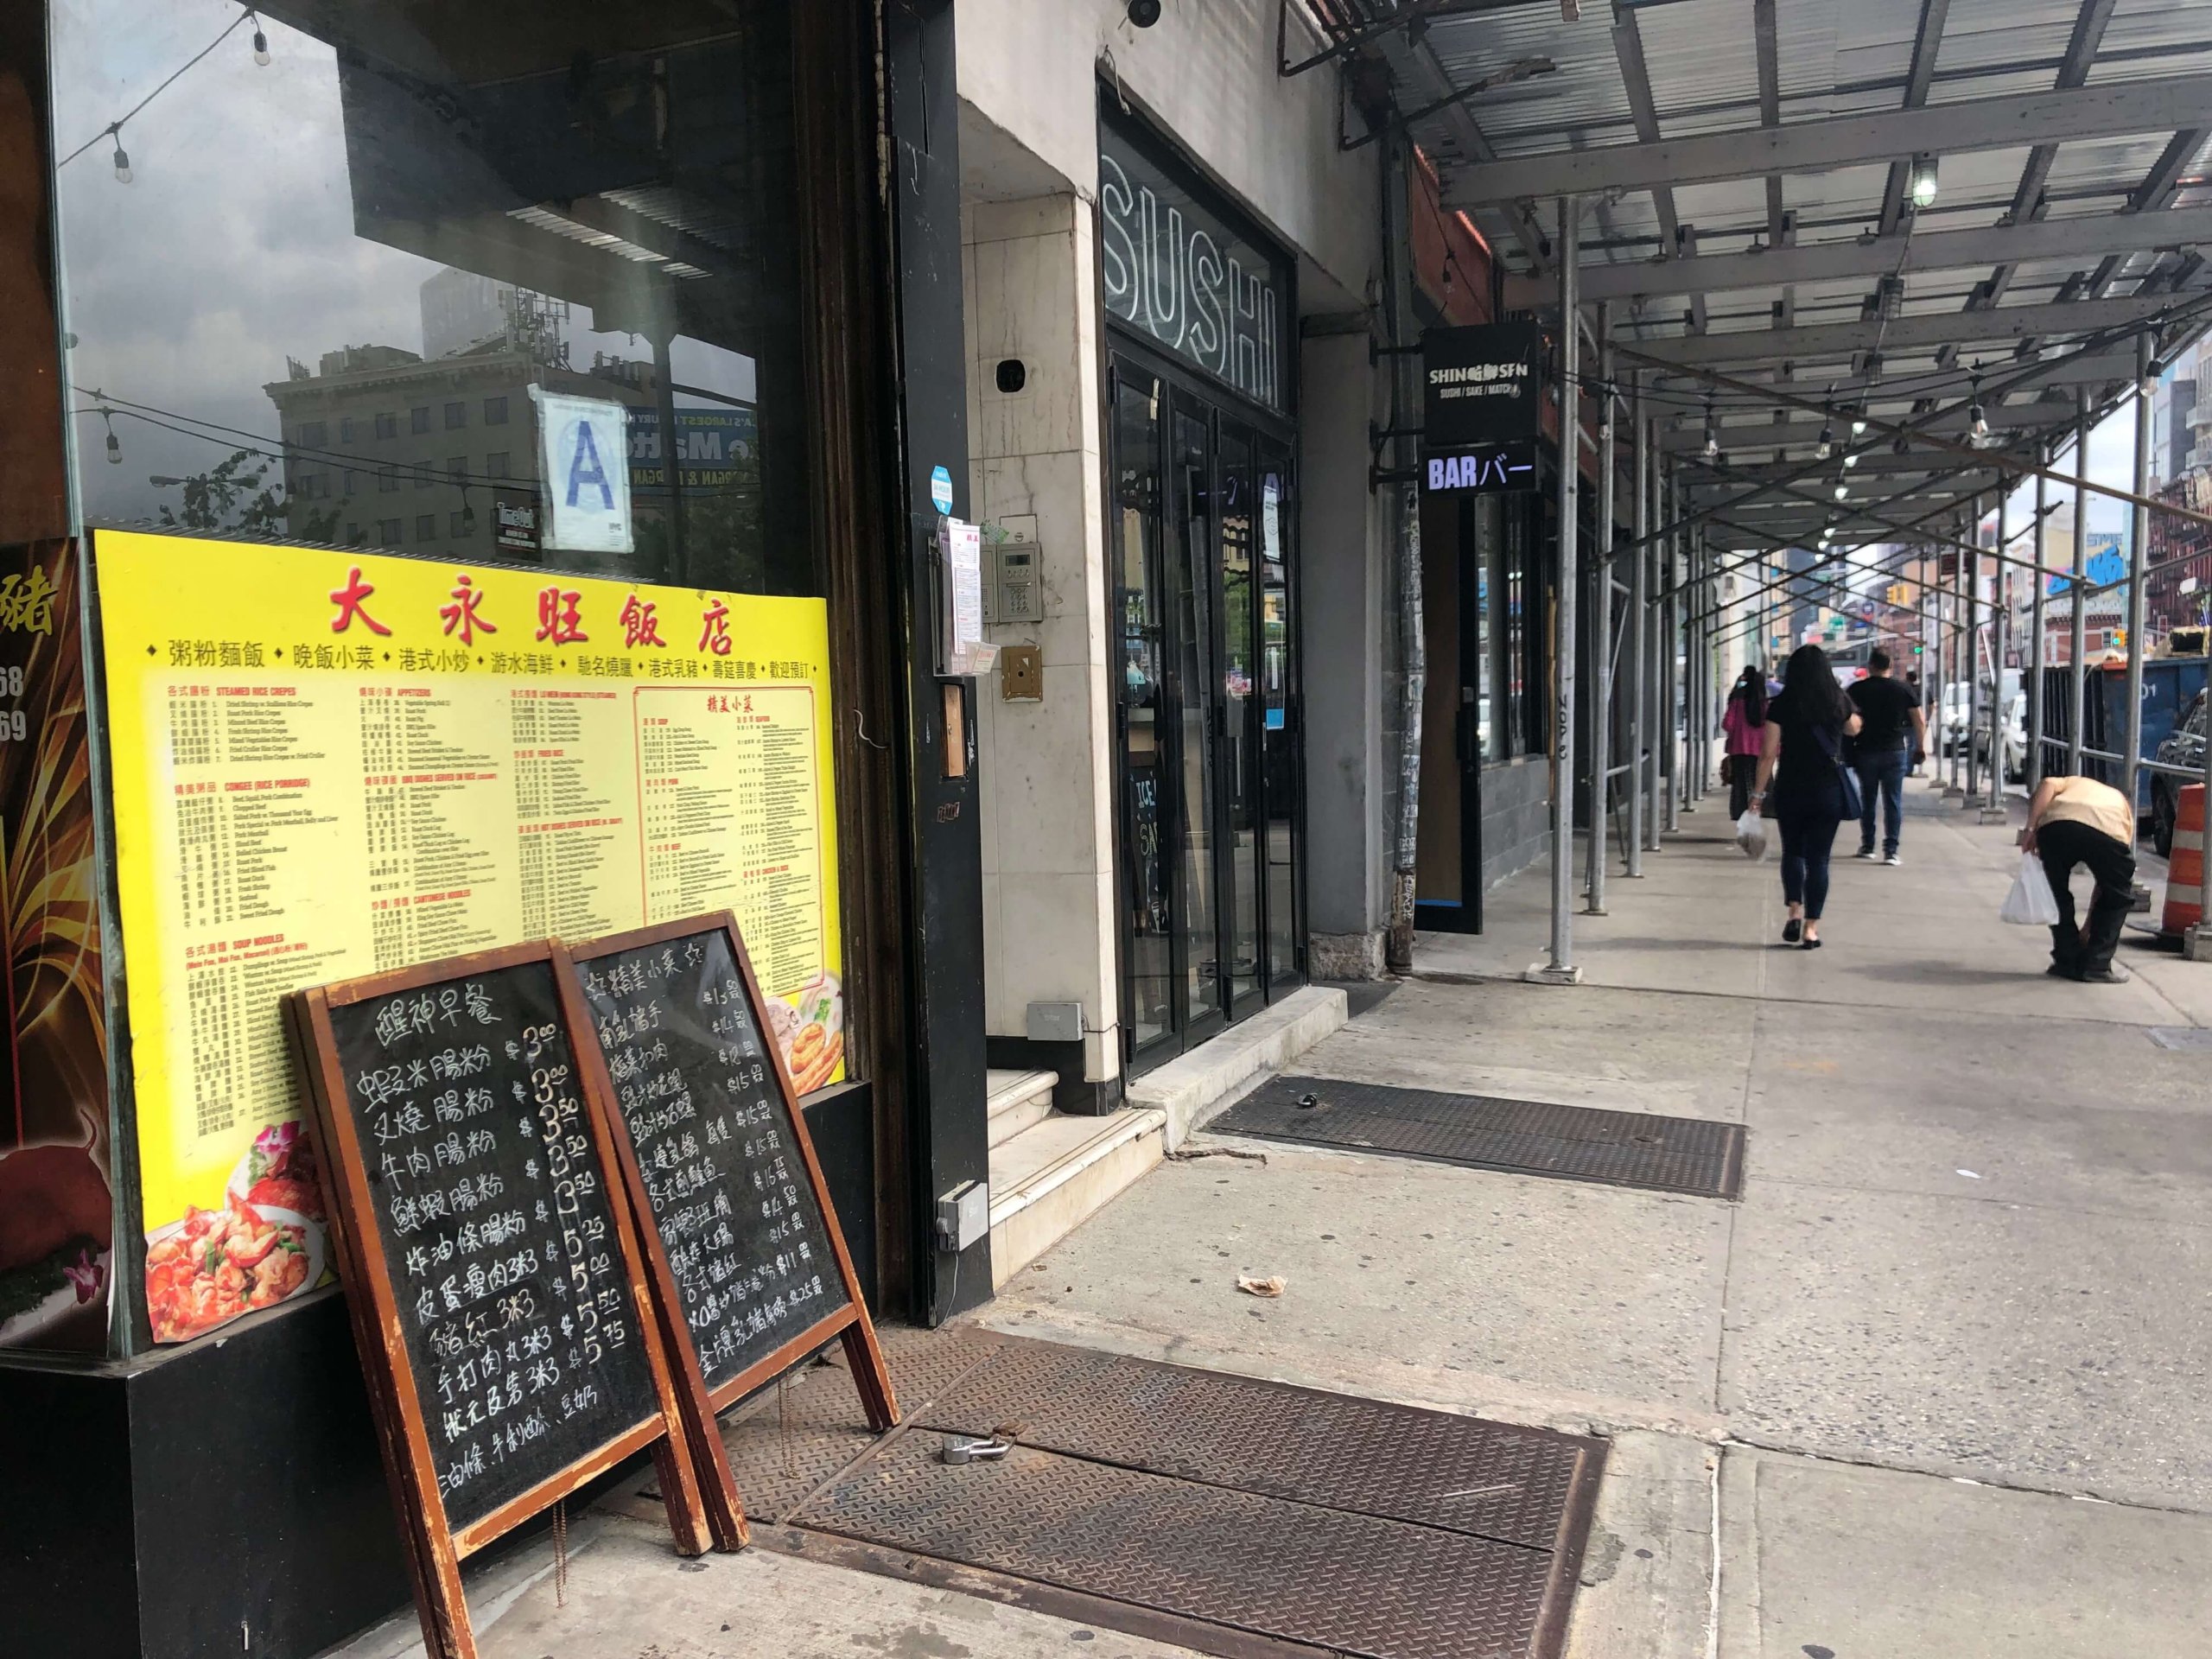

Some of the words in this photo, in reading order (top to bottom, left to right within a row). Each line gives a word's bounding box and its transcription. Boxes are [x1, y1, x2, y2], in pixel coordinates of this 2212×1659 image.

[1101, 155, 1279, 409] SUSHI
[566, 420, 615, 510] A
[1428, 455, 1477, 491] BAR
[1479, 453, 1533, 486] バー
[329, 566, 734, 657] 大永旺飯店
[168, 639, 265, 669] 粥粉麵飯
[293, 643, 374, 671] 晚飯小菜
[398, 647, 469, 672] 港式小炒
[491, 652, 554, 676] 游水海鮮
[375, 983, 502, 1046] 醒神早餐
[357, 1044, 492, 1113] 蝦米腸粉
[374, 1087, 494, 1146] 叉燒腸粉
[381, 1128, 496, 1192] 牛肉腸粉
[391, 1173, 504, 1237] 鮮蝦腸粉
[406, 1210, 526, 1277] 炸油條腸粉
[436, 1325, 552, 1405] 手打肉丸粥
